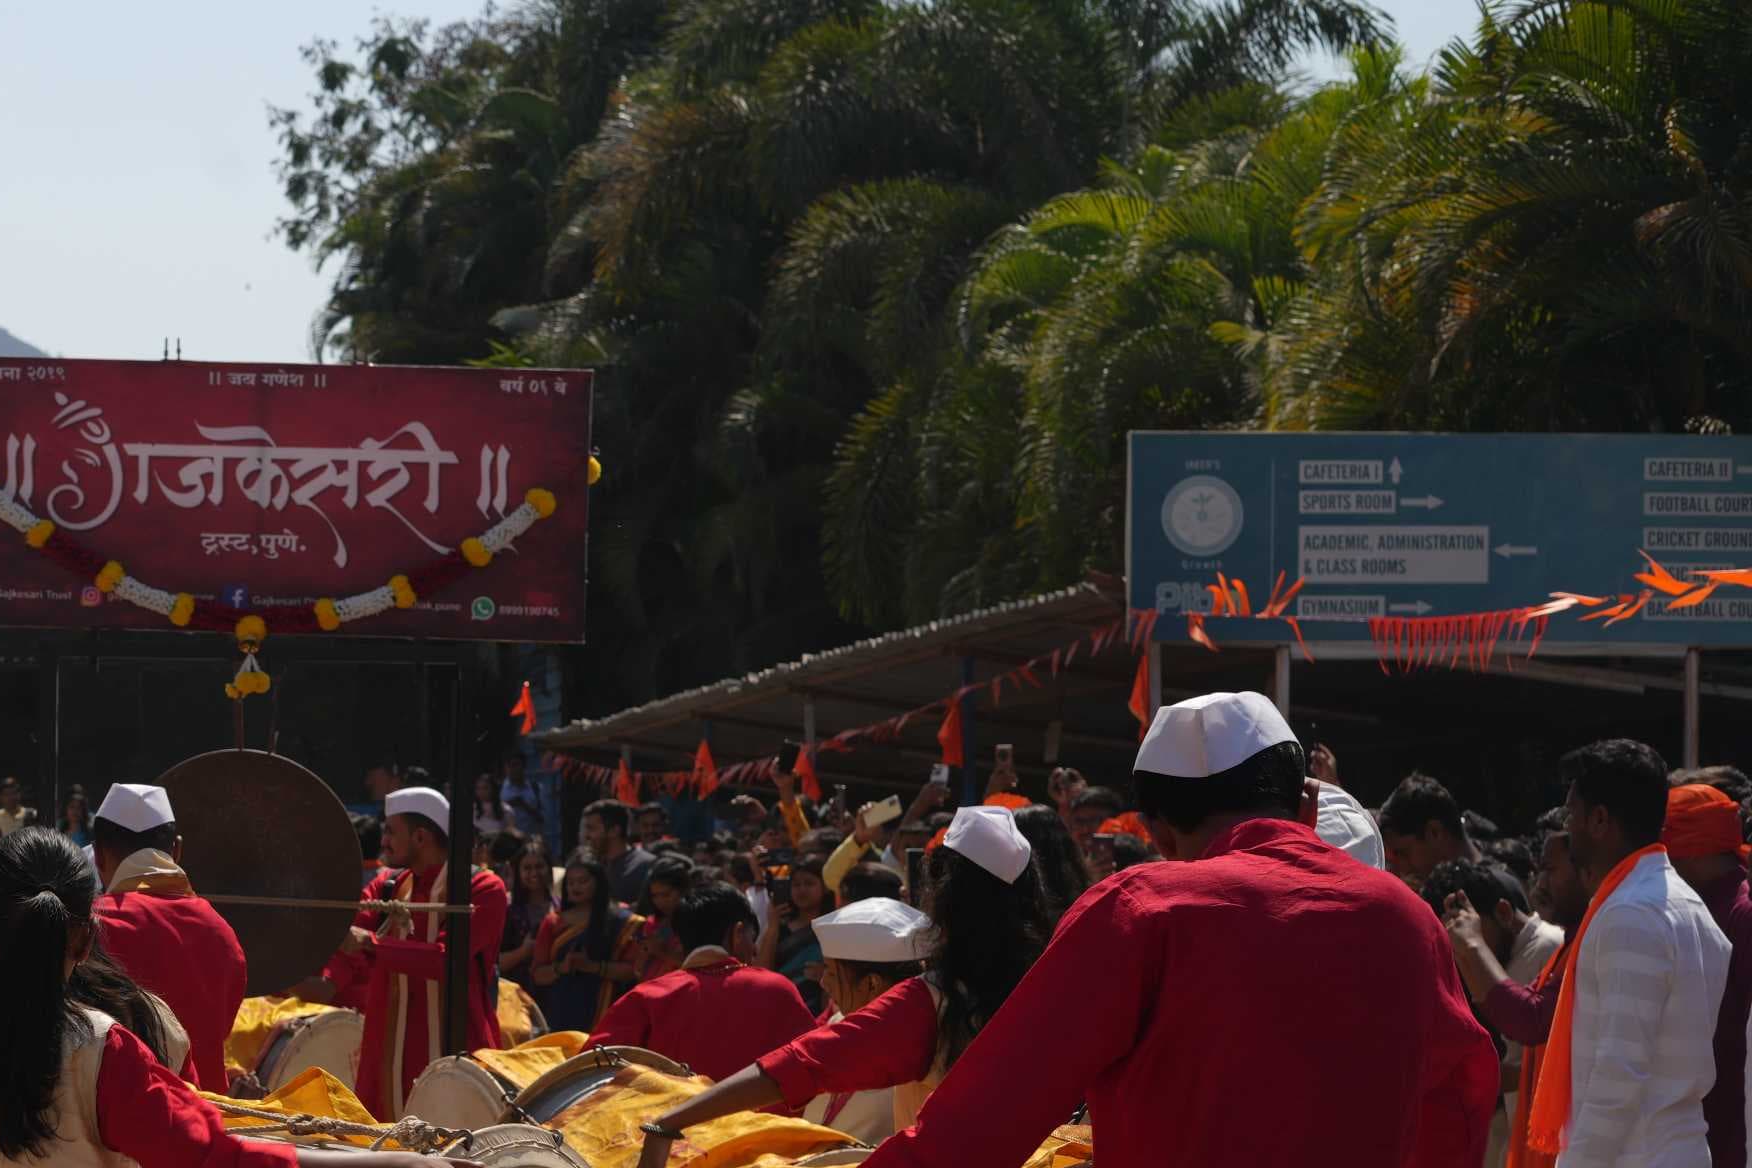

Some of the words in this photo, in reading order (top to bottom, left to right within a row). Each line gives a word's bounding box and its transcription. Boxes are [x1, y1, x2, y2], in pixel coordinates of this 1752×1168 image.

[226, 372, 257, 386] जय
[261, 368, 304, 387] गणेश
[499, 376, 524, 394] वर्ष
[1303, 463, 1370, 480] CAFETERIA
[1649, 461, 1714, 477] CAFETERIA
[1720, 461, 1728, 477] II
[1302, 494, 1351, 510] SPORTS
[1358, 494, 1393, 510] ROOM
[1650, 496, 1711, 513] FOOTBALL
[1304, 535, 1373, 551] ACADEMIC,
[1378, 535, 1484, 549] ADMINISTRATION
[1648, 532, 1700, 546] CRICKET
[1304, 559, 1312, 575] &
[1317, 559, 1356, 575] CLASS
[1362, 559, 1406, 575] ROOMS
[46, 589, 72, 601] Trust
[1302, 600, 1379, 615] GYMNASIUM
